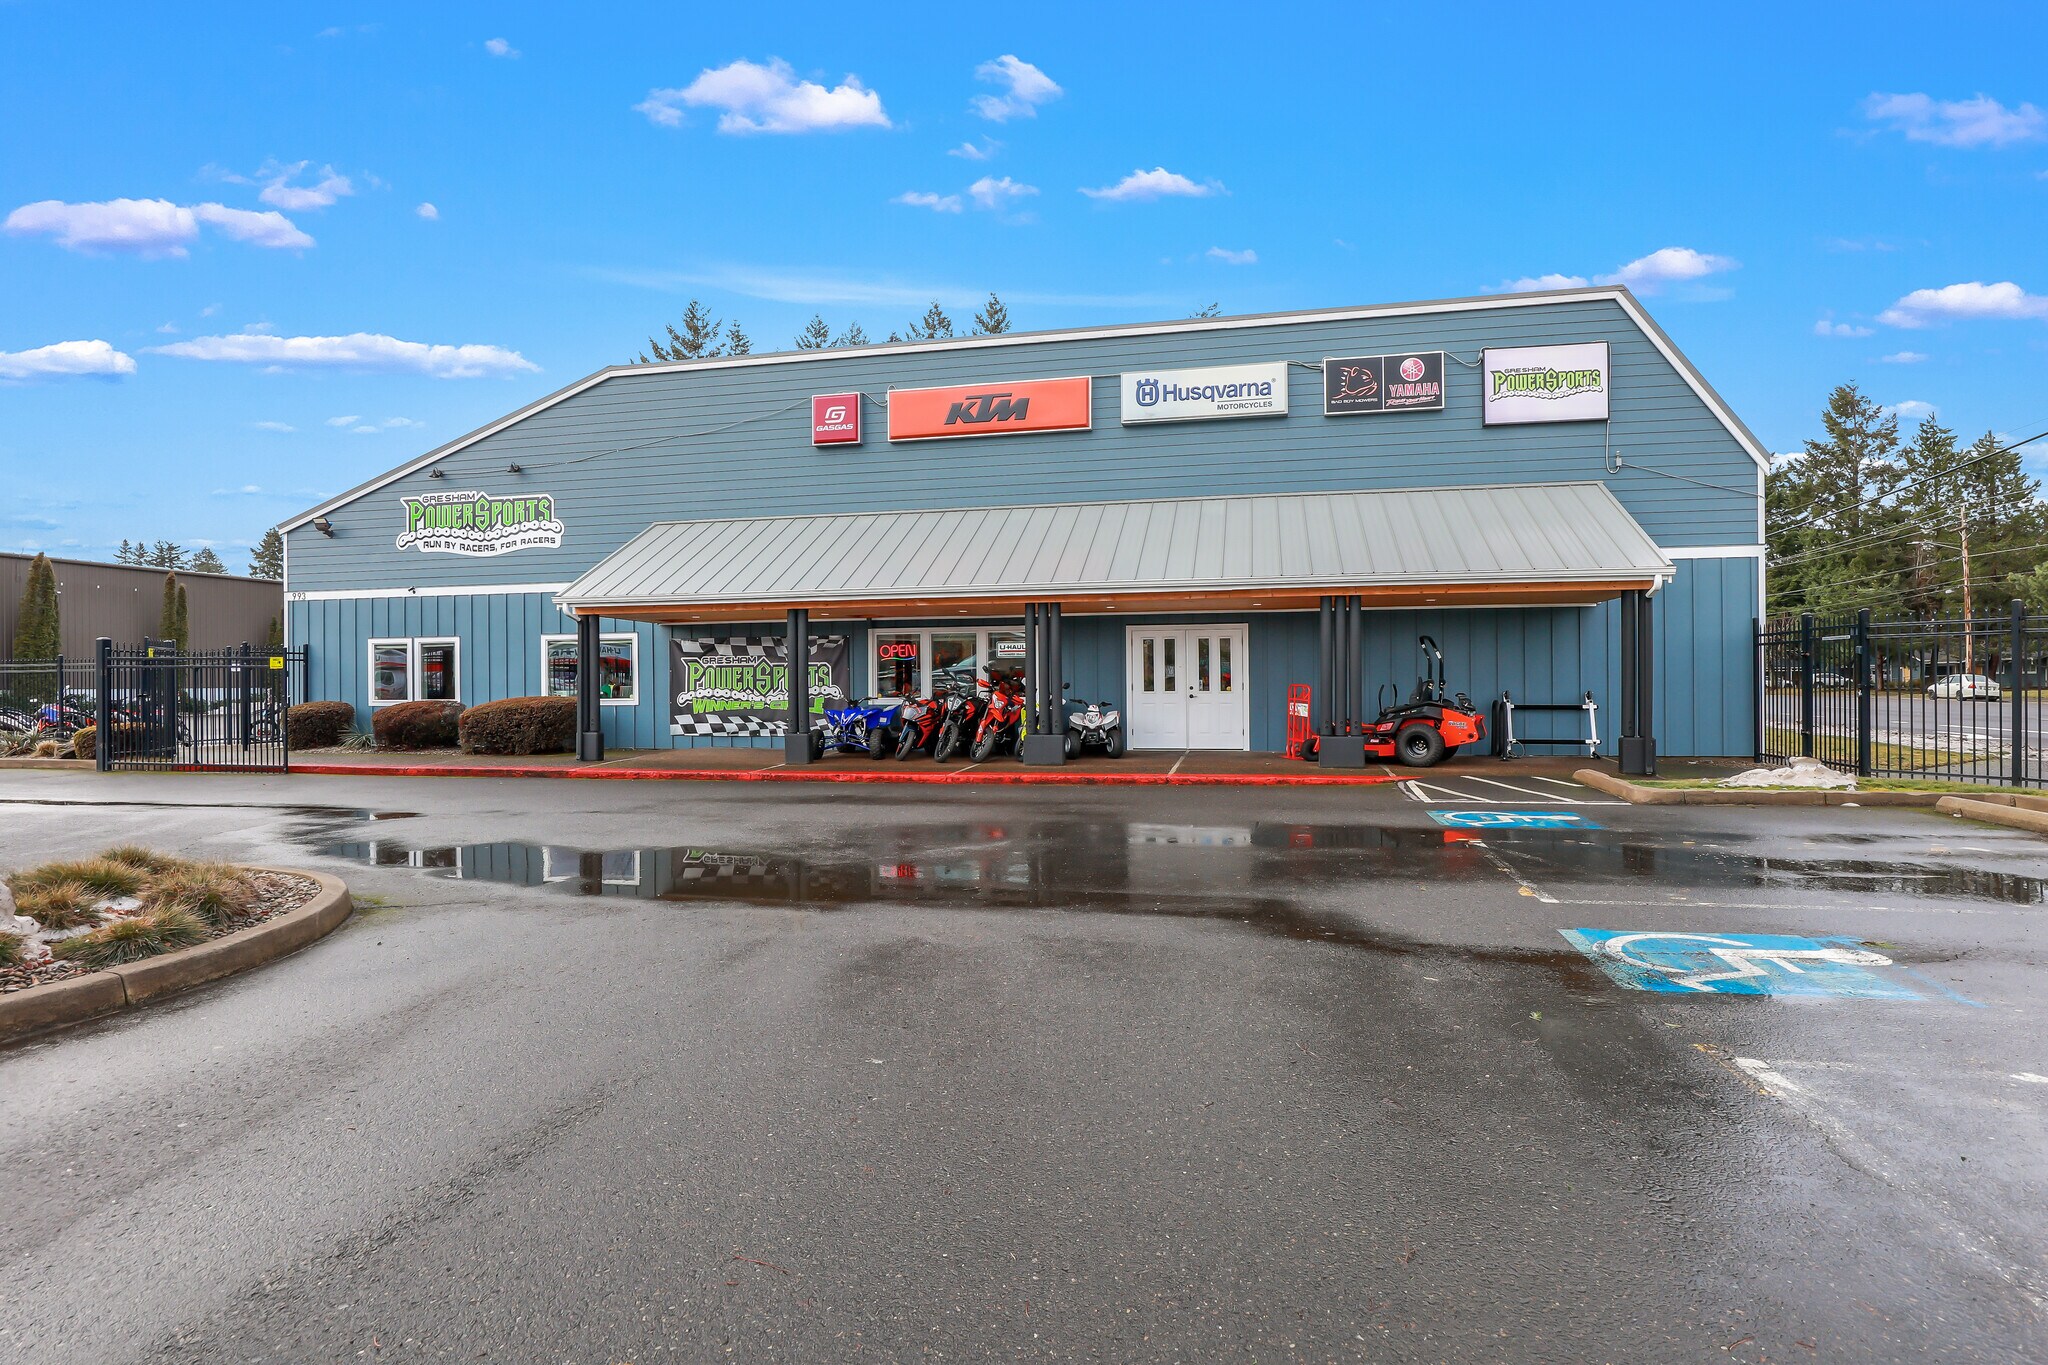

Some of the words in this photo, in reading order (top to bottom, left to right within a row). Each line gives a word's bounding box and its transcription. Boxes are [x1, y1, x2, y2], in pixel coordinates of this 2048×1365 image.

[1504, 366, 1546, 374] GRESHAM
[1163, 381, 1272, 402] Husqvarna
[1389, 382, 1439, 397] YAMAHA
[944, 393, 1030, 425] KTM
[1216, 400, 1273, 411] MOTORCYCLES
[816, 423, 854, 432] GASGAS
[422, 493, 476, 504] GRESHAM
[423, 541, 442, 549] RUN
[459, 543, 498, 552] RACERS,
[500, 541, 518, 550] FOR
[520, 536, 556, 545] RACERS
[292, 592, 305, 600] 993
[879, 644, 917, 658] OPEN
[702, 656, 757, 664] GRESHAM
[692, 698, 765, 714] WINNER'S
